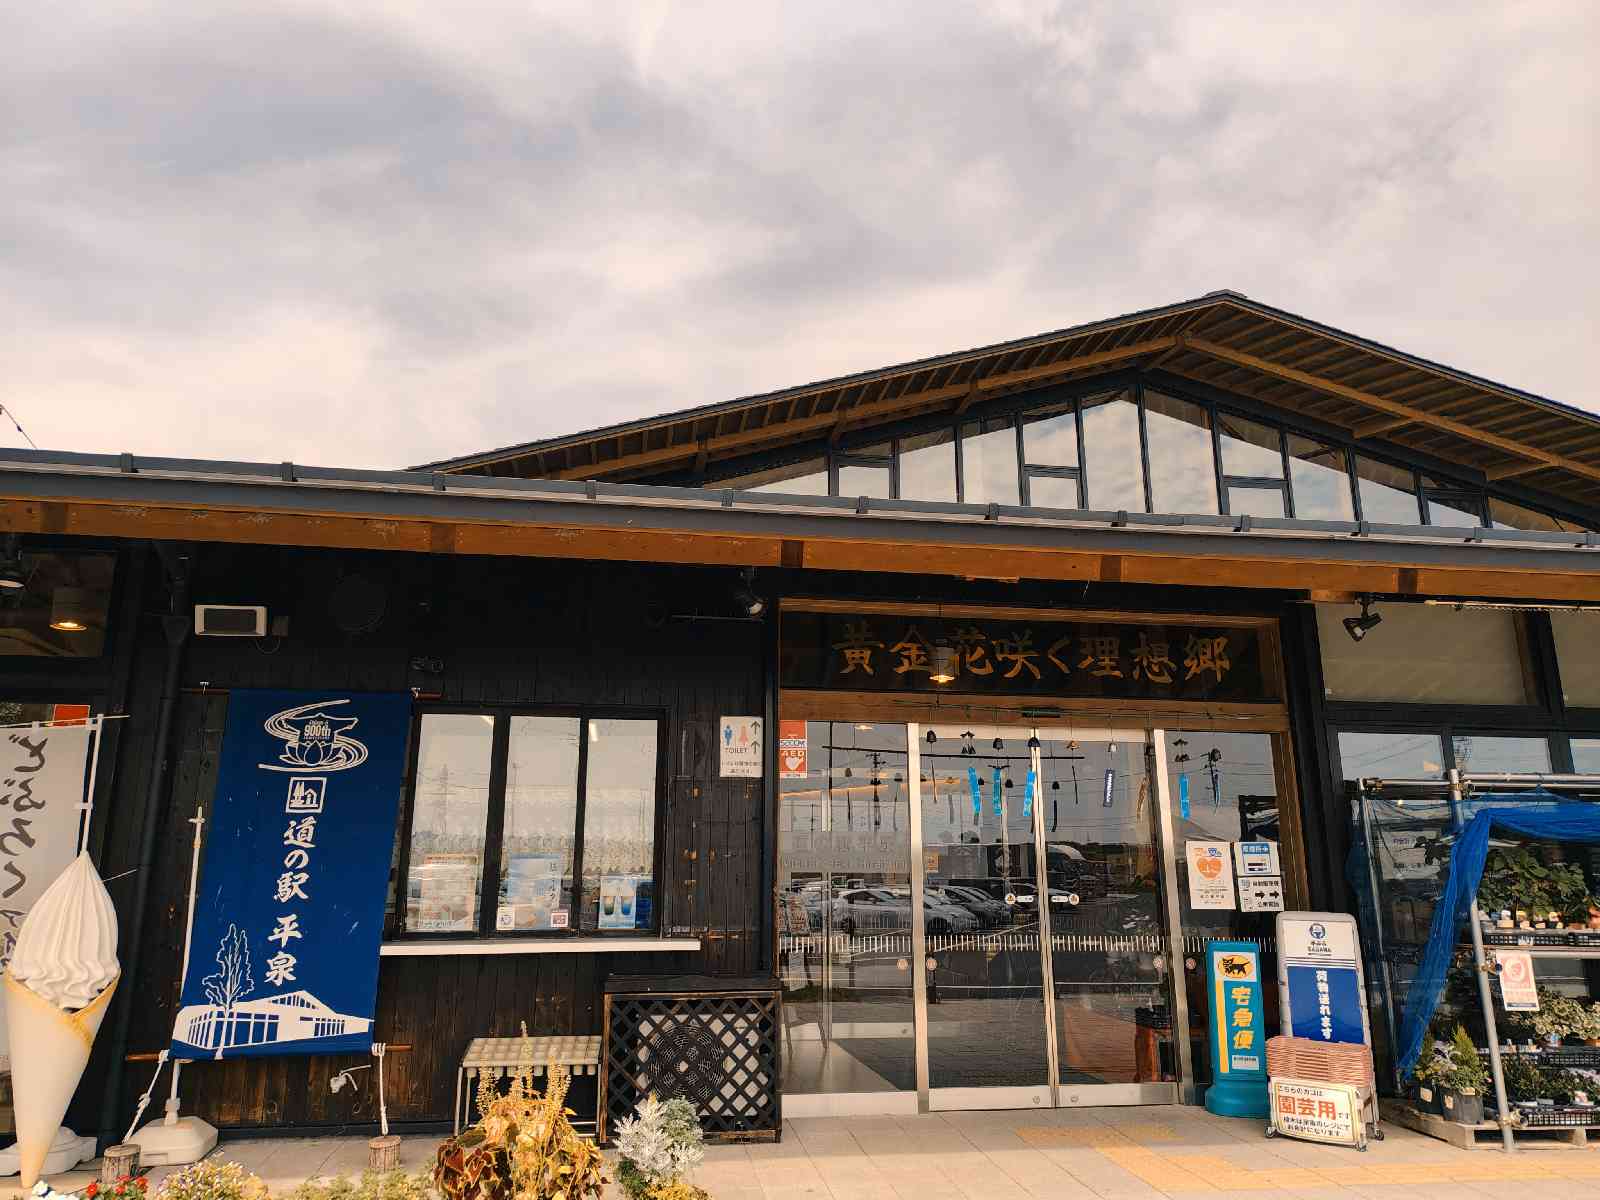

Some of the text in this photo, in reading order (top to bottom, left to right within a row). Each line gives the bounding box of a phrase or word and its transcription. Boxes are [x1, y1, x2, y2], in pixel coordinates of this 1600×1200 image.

[832, 620, 1232, 684] 黄金花咲く理想郷
[1231, 986, 1254, 1050] 宅急便
[1278, 1095, 1337, 1120] 園芸用
